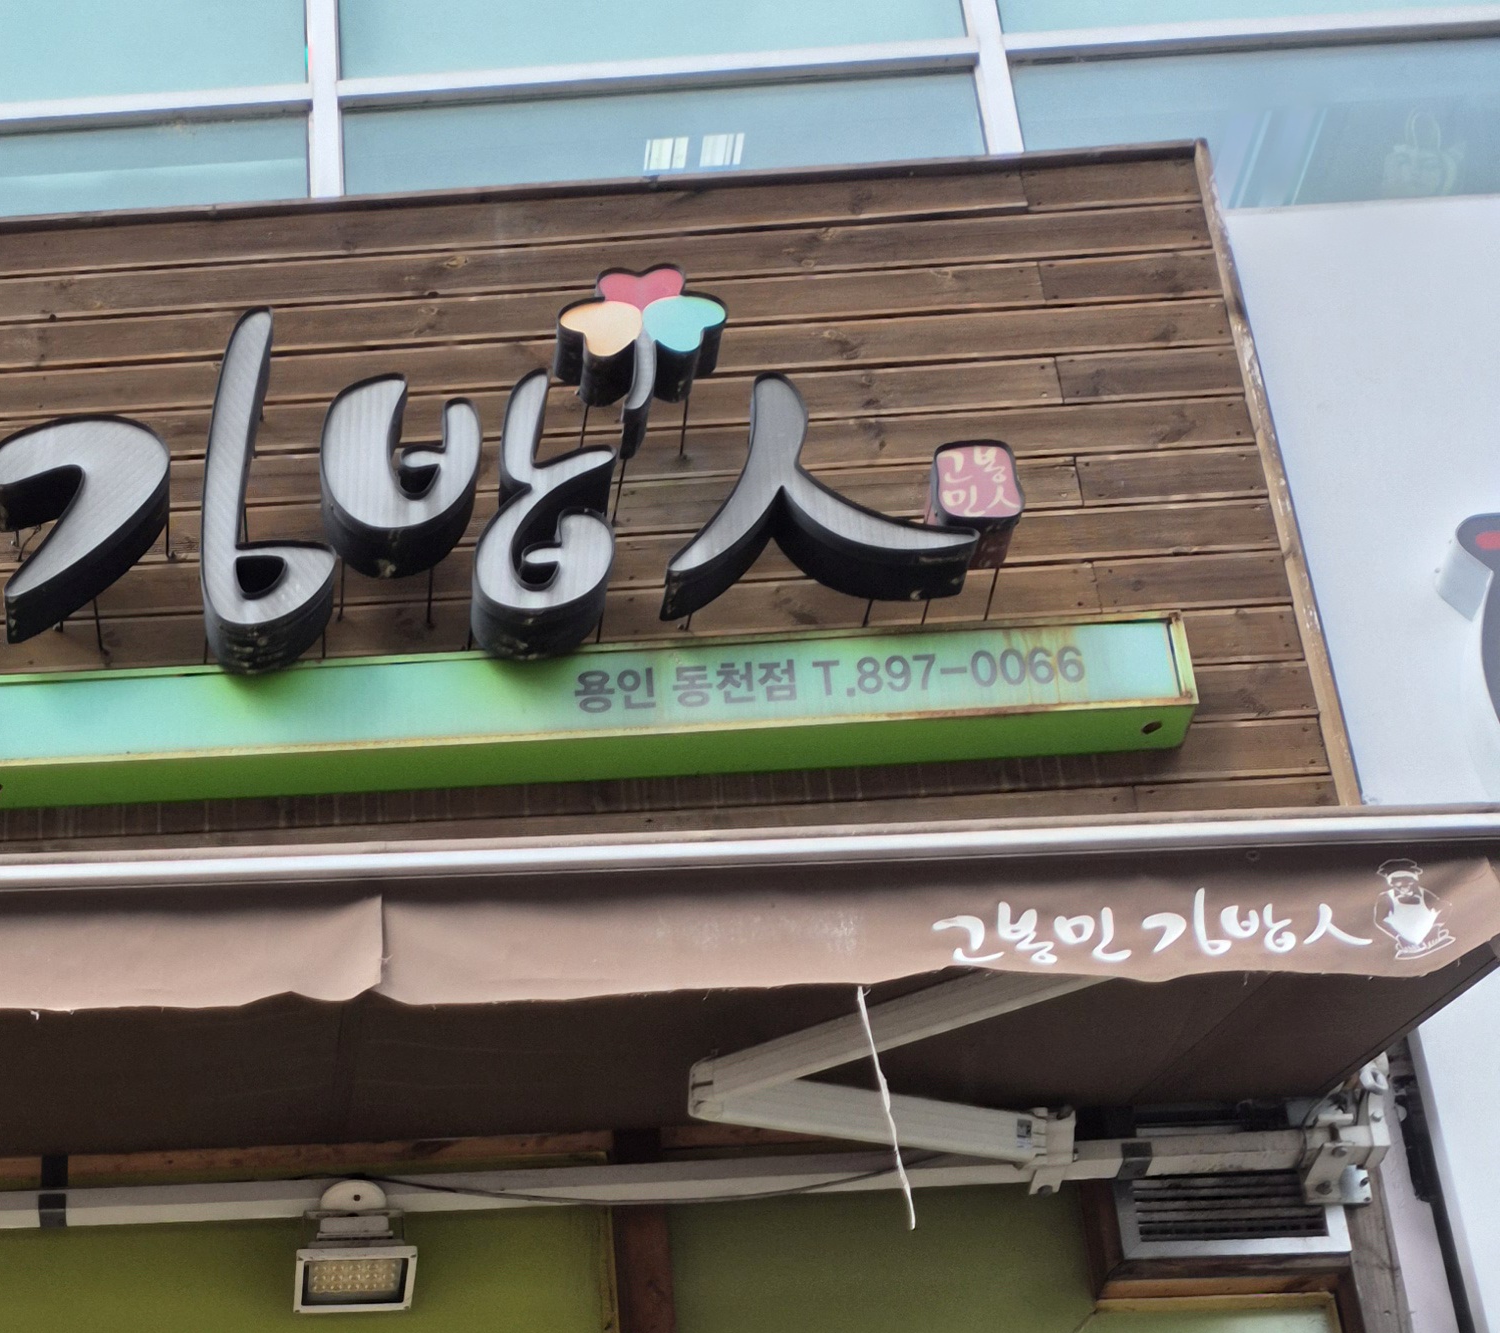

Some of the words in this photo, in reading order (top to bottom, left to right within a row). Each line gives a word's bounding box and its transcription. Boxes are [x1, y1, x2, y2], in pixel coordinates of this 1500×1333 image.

[574, 667, 657, 714] 용인
[671, 658, 798, 709] 동천점
[812, 645, 1086, 699] T.897-0066
